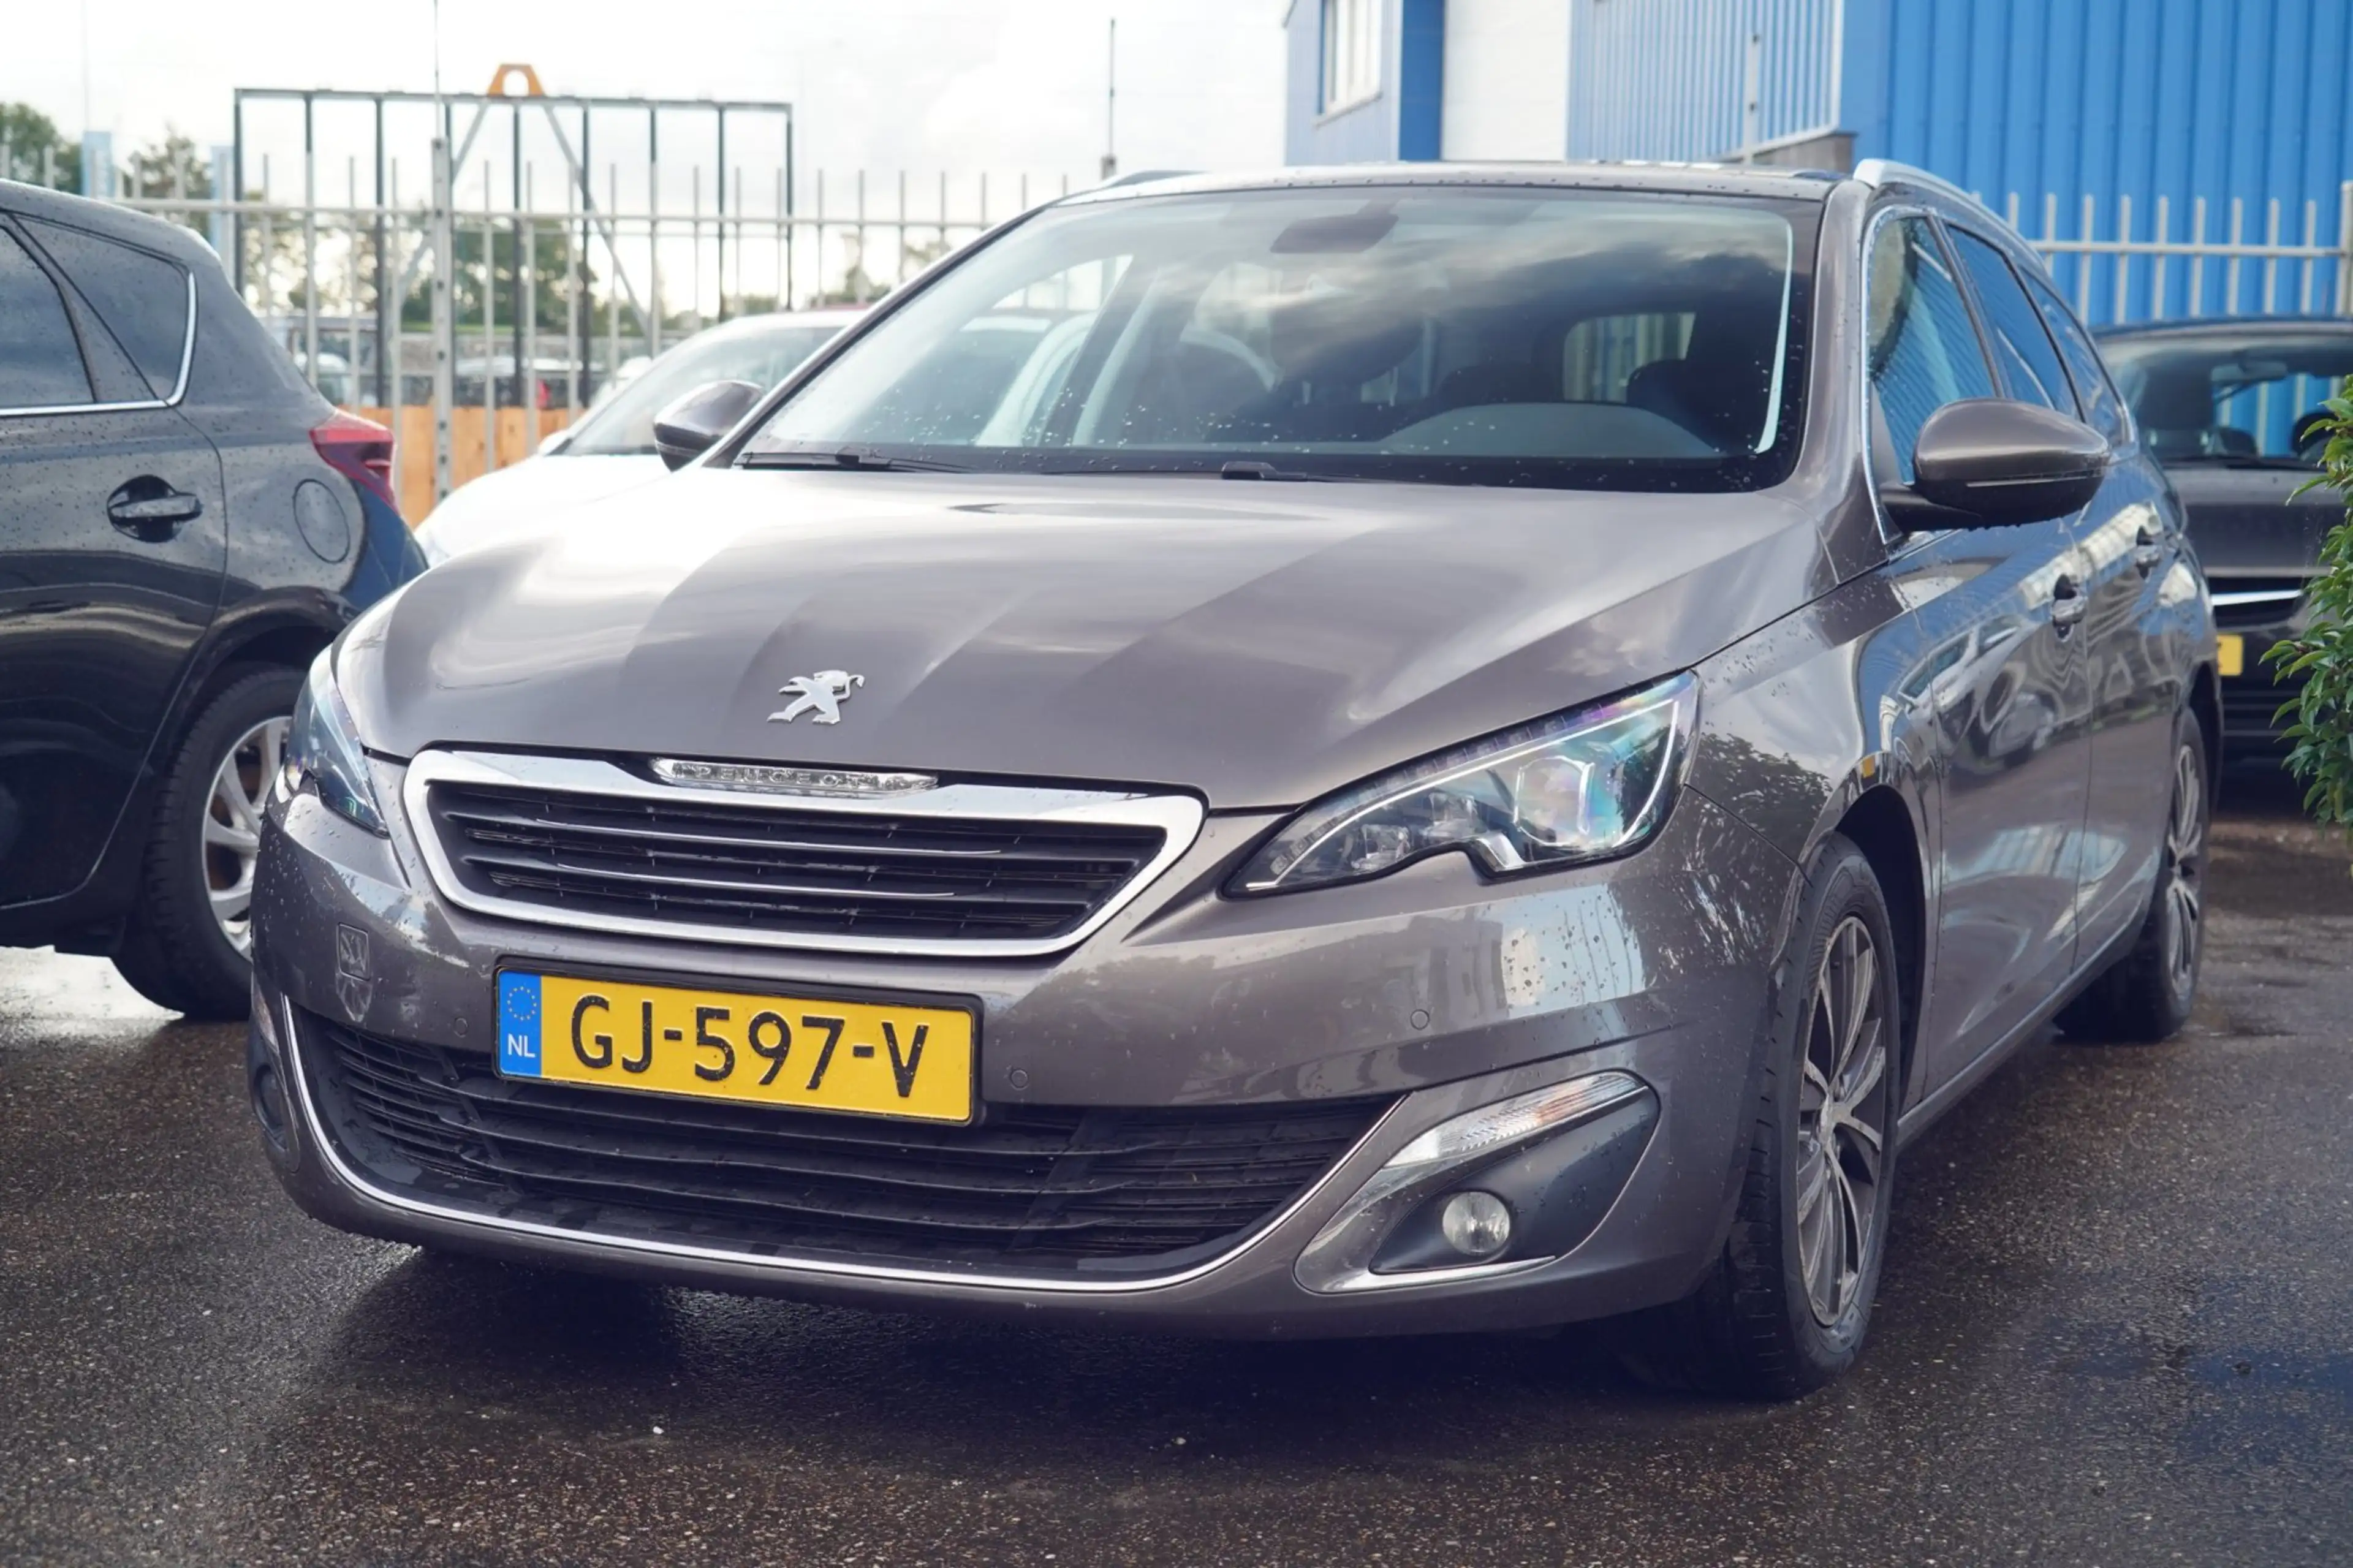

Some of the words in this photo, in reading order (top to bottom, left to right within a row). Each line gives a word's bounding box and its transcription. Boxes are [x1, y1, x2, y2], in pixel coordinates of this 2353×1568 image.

[695, 767, 865, 787] PEUGEOT
[507, 1033, 536, 1058] NL
[570, 994, 930, 1098] GJ-597-V
